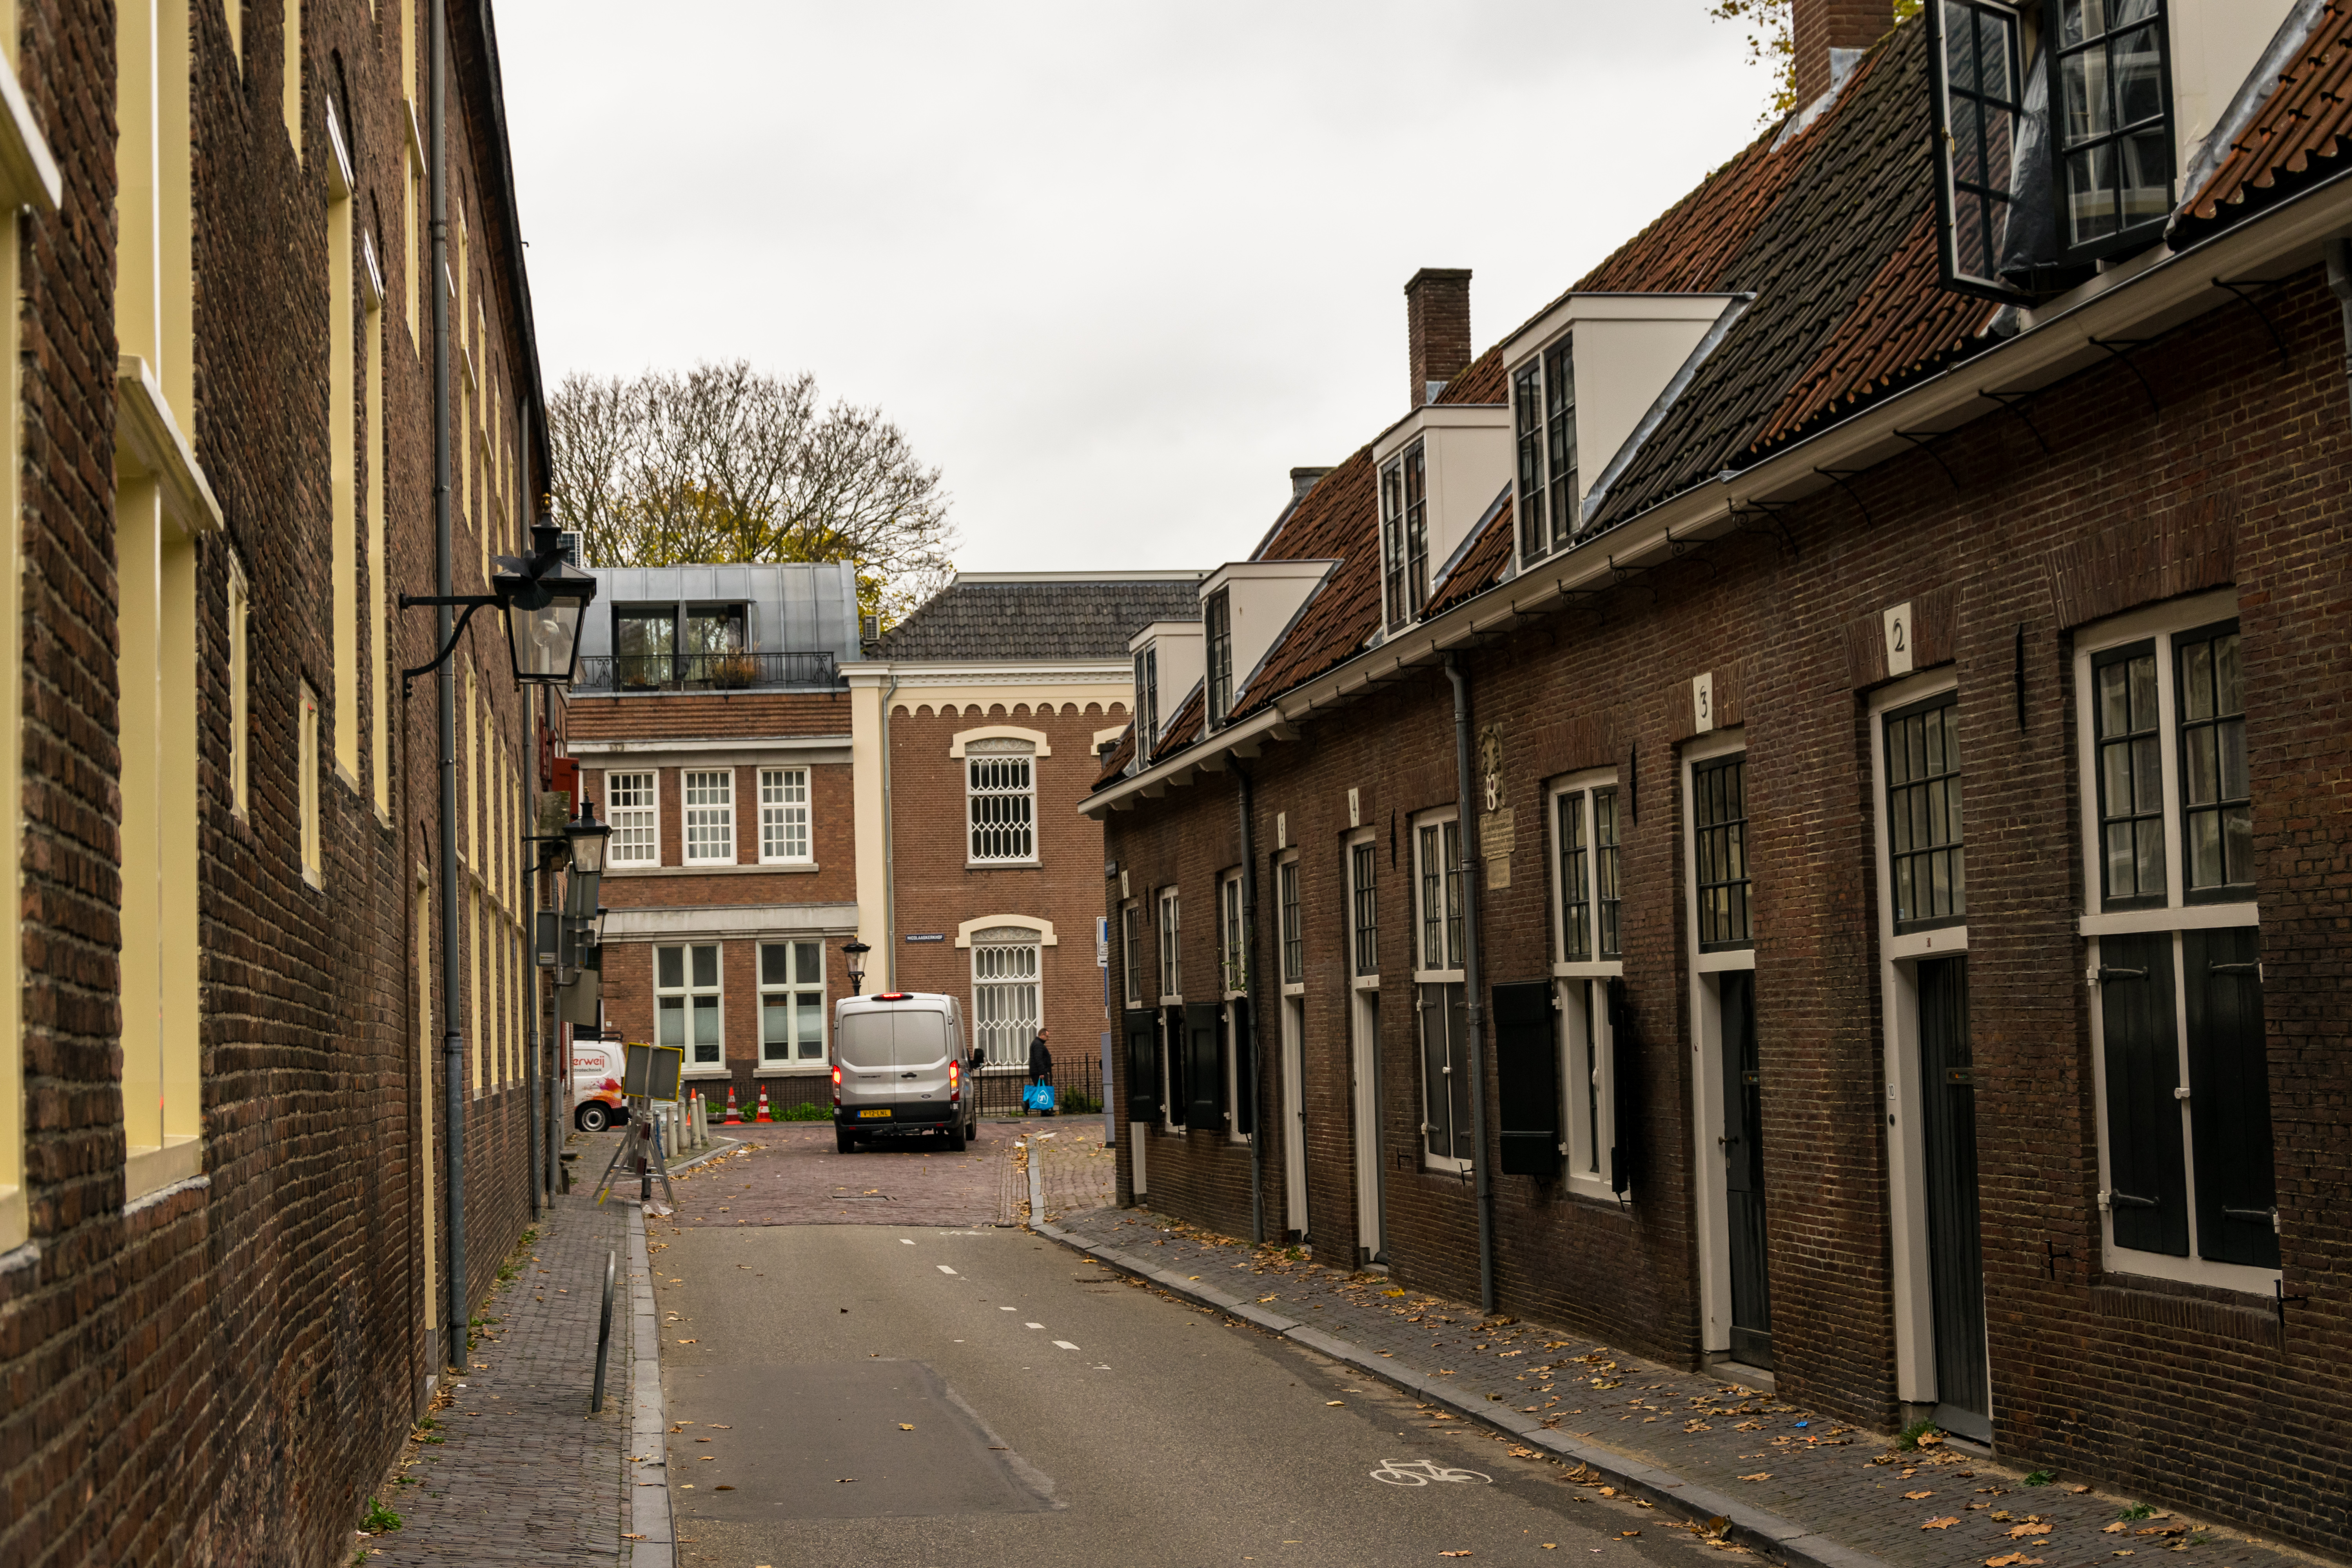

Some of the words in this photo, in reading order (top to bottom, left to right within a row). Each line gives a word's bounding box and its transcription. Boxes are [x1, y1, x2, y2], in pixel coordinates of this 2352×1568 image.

[1893, 618, 1905, 652] 2
[1700, 686, 1707, 719] 3
[1352, 795, 1357, 818] 4
[1889, 1085, 1894, 1096] 10
